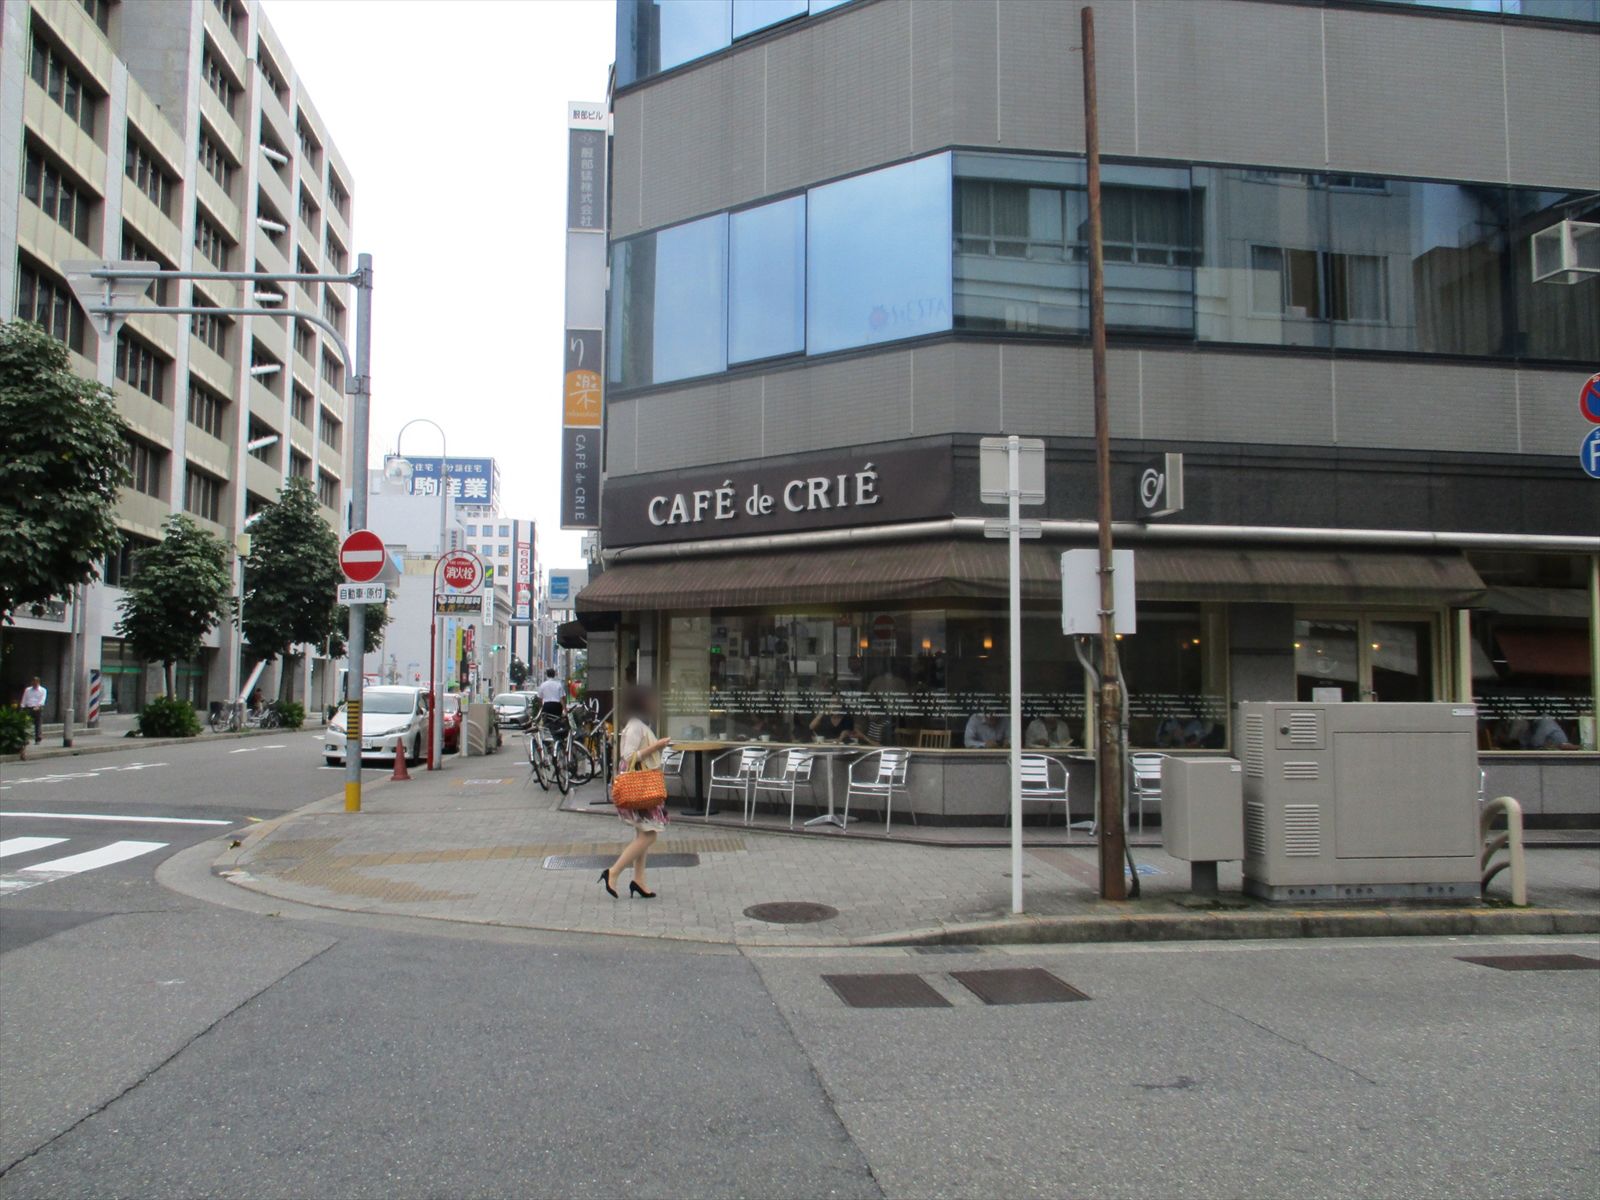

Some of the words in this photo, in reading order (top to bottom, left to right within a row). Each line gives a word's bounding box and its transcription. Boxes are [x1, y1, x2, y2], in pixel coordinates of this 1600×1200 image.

[573, 109, 603, 120] 服部ビル
[648, 479, 737, 527] CAFÉ
[745, 483, 775, 516] de
[783, 462, 881, 513] CRIÉ
[446, 566, 474, 580] 消火栓
